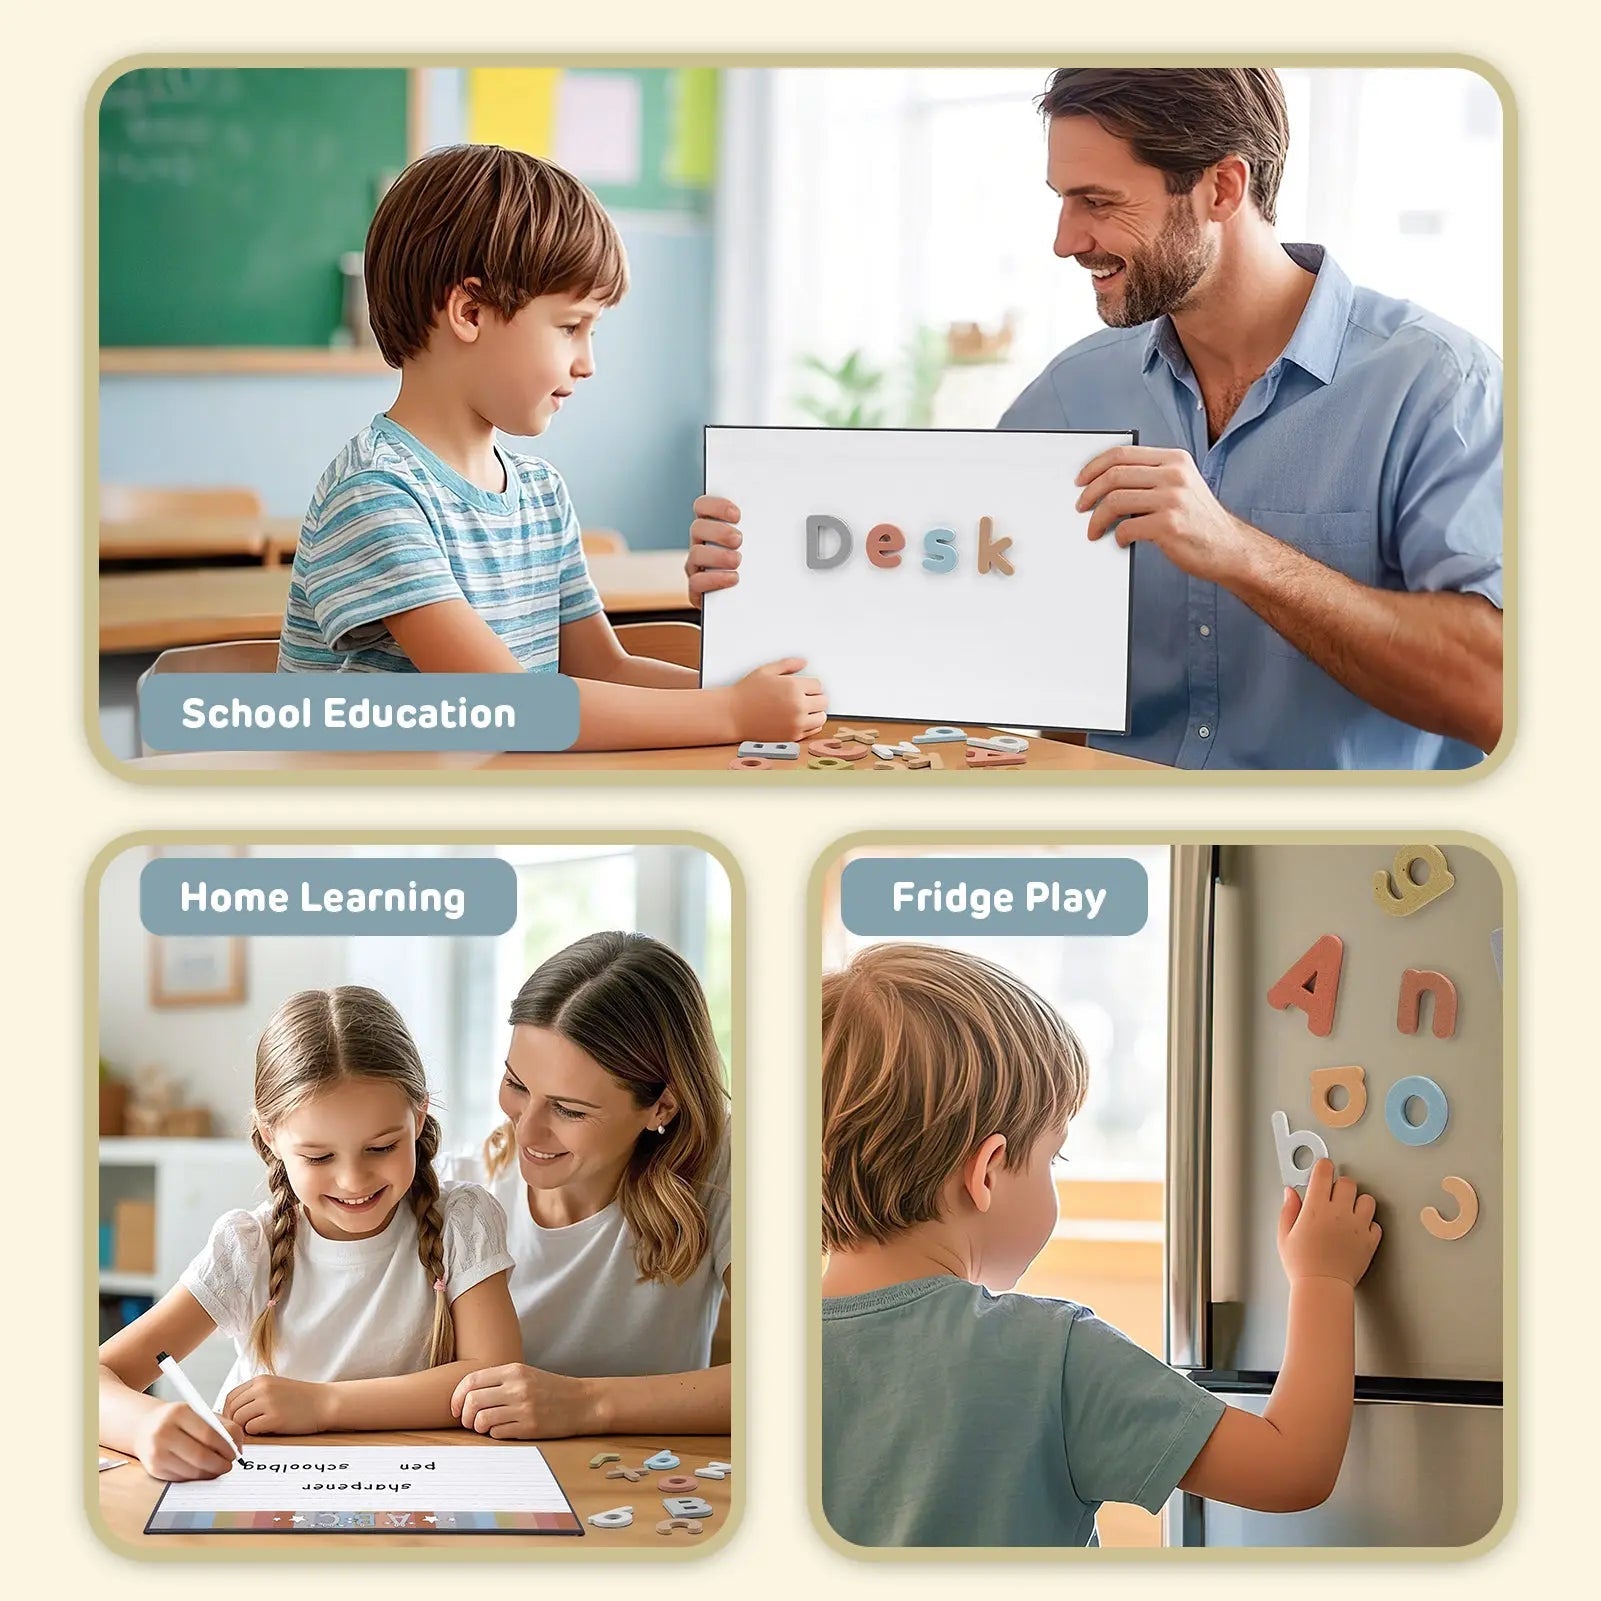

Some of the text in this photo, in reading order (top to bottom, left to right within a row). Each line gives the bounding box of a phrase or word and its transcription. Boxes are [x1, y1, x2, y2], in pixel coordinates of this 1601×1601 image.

[805, 514, 1016, 576] Desk
[243, 1460, 436, 1473] pen schoolbag
[301, 1481, 412, 1492] sharpener
